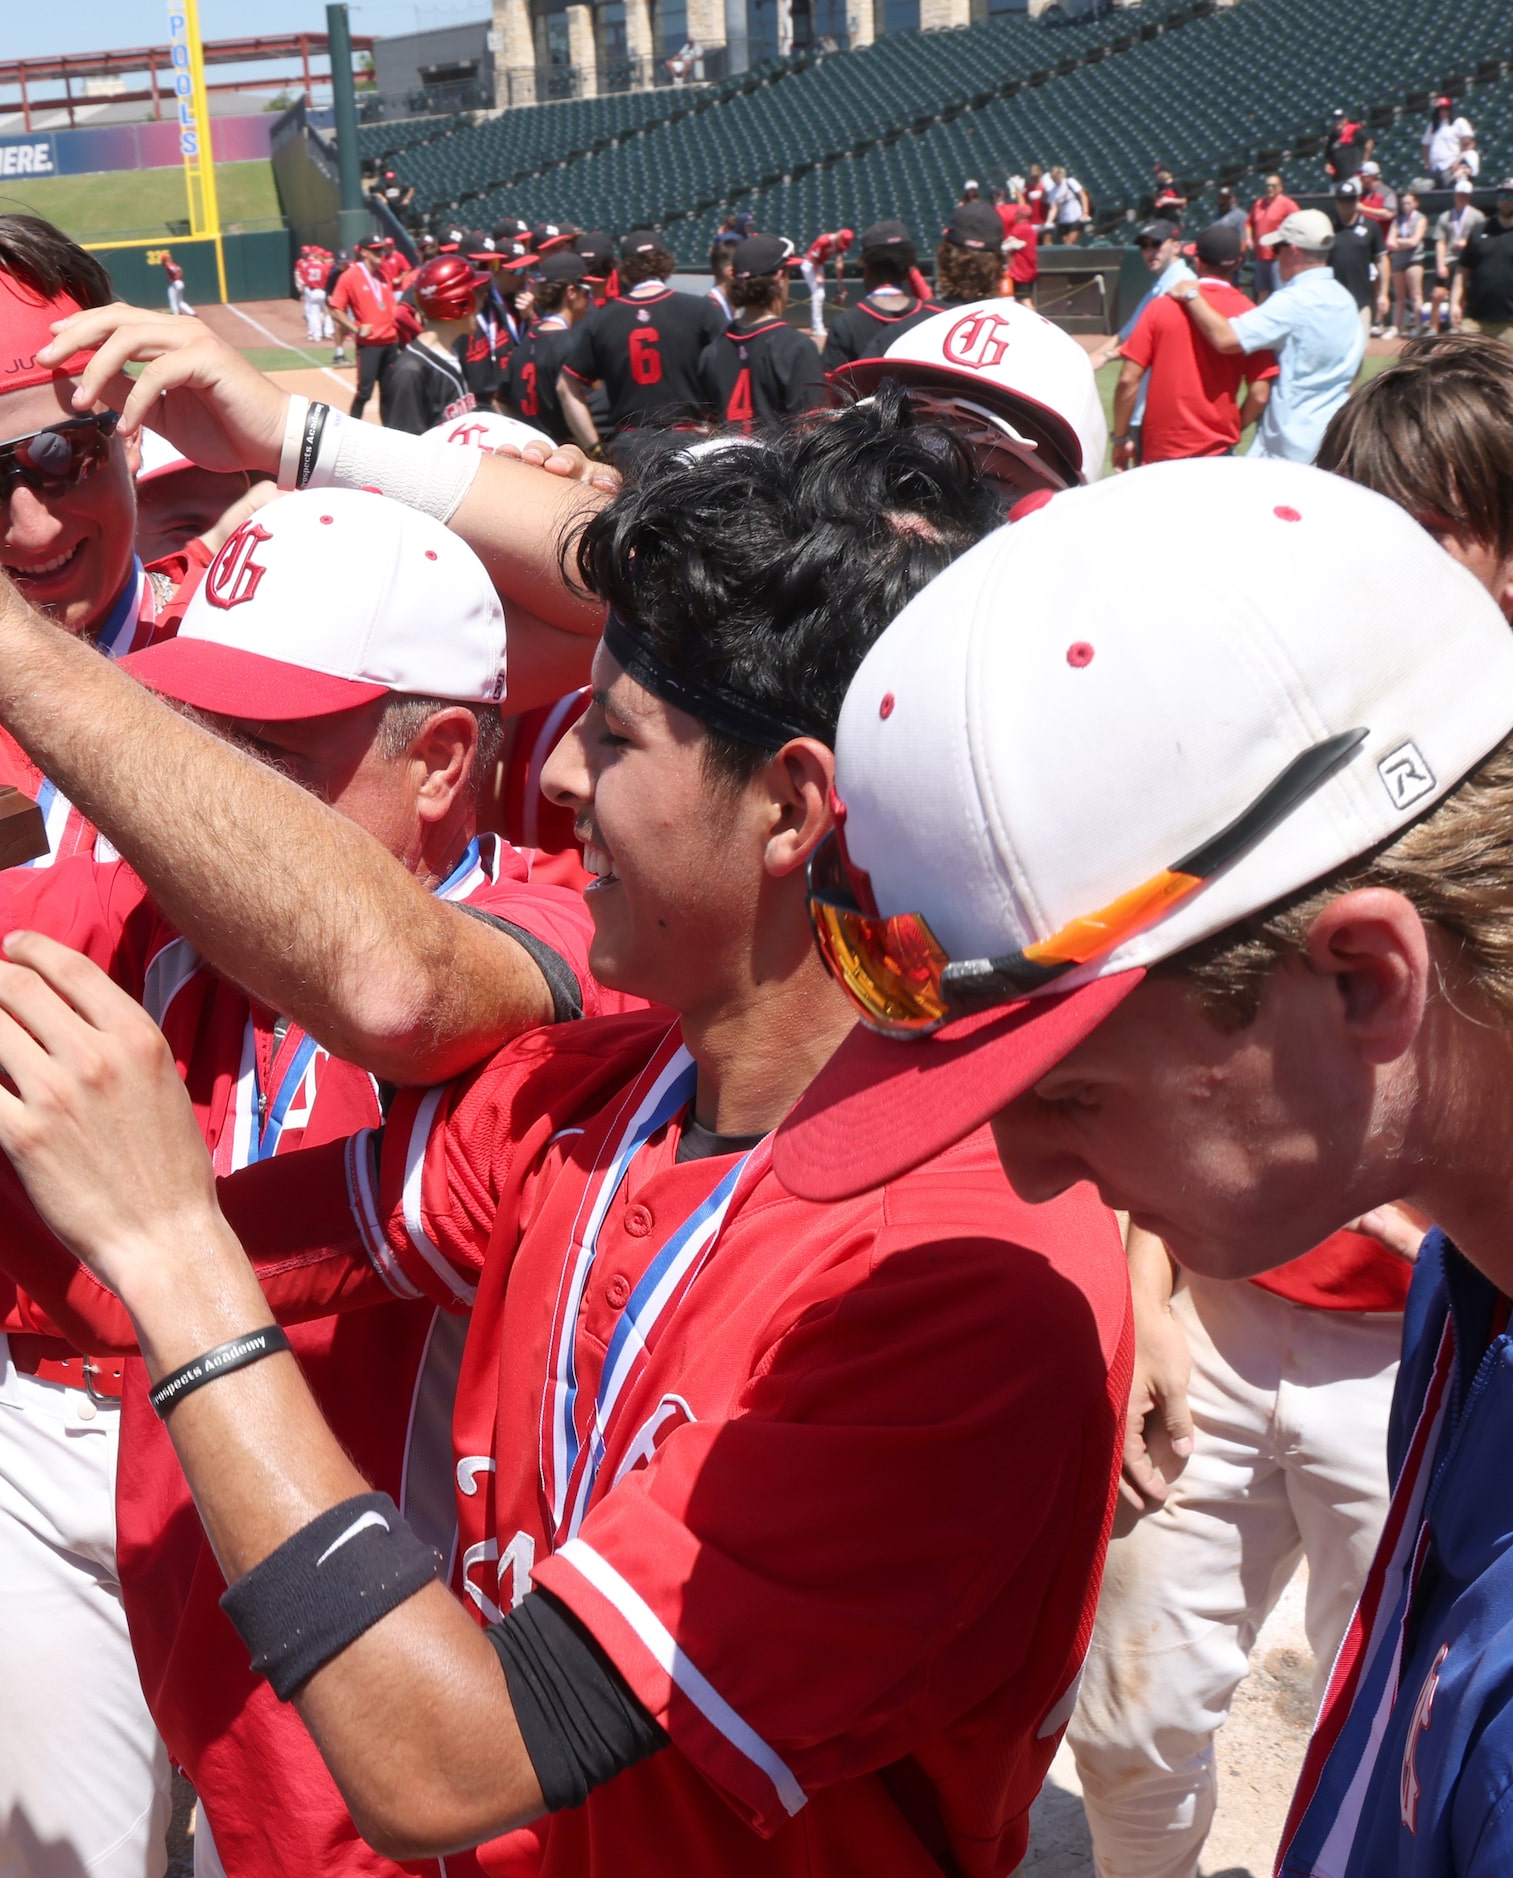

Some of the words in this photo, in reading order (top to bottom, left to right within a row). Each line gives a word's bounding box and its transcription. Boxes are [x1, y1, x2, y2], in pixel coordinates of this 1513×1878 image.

[628, 326, 664, 385] 6
[942, 309, 1010, 370] G
[520, 362, 540, 417] 3
[726, 367, 755, 440] 4
[205, 519, 274, 611] G
[153, 1366, 203, 1406] rospects
[204, 1335, 266, 1372] Academy
